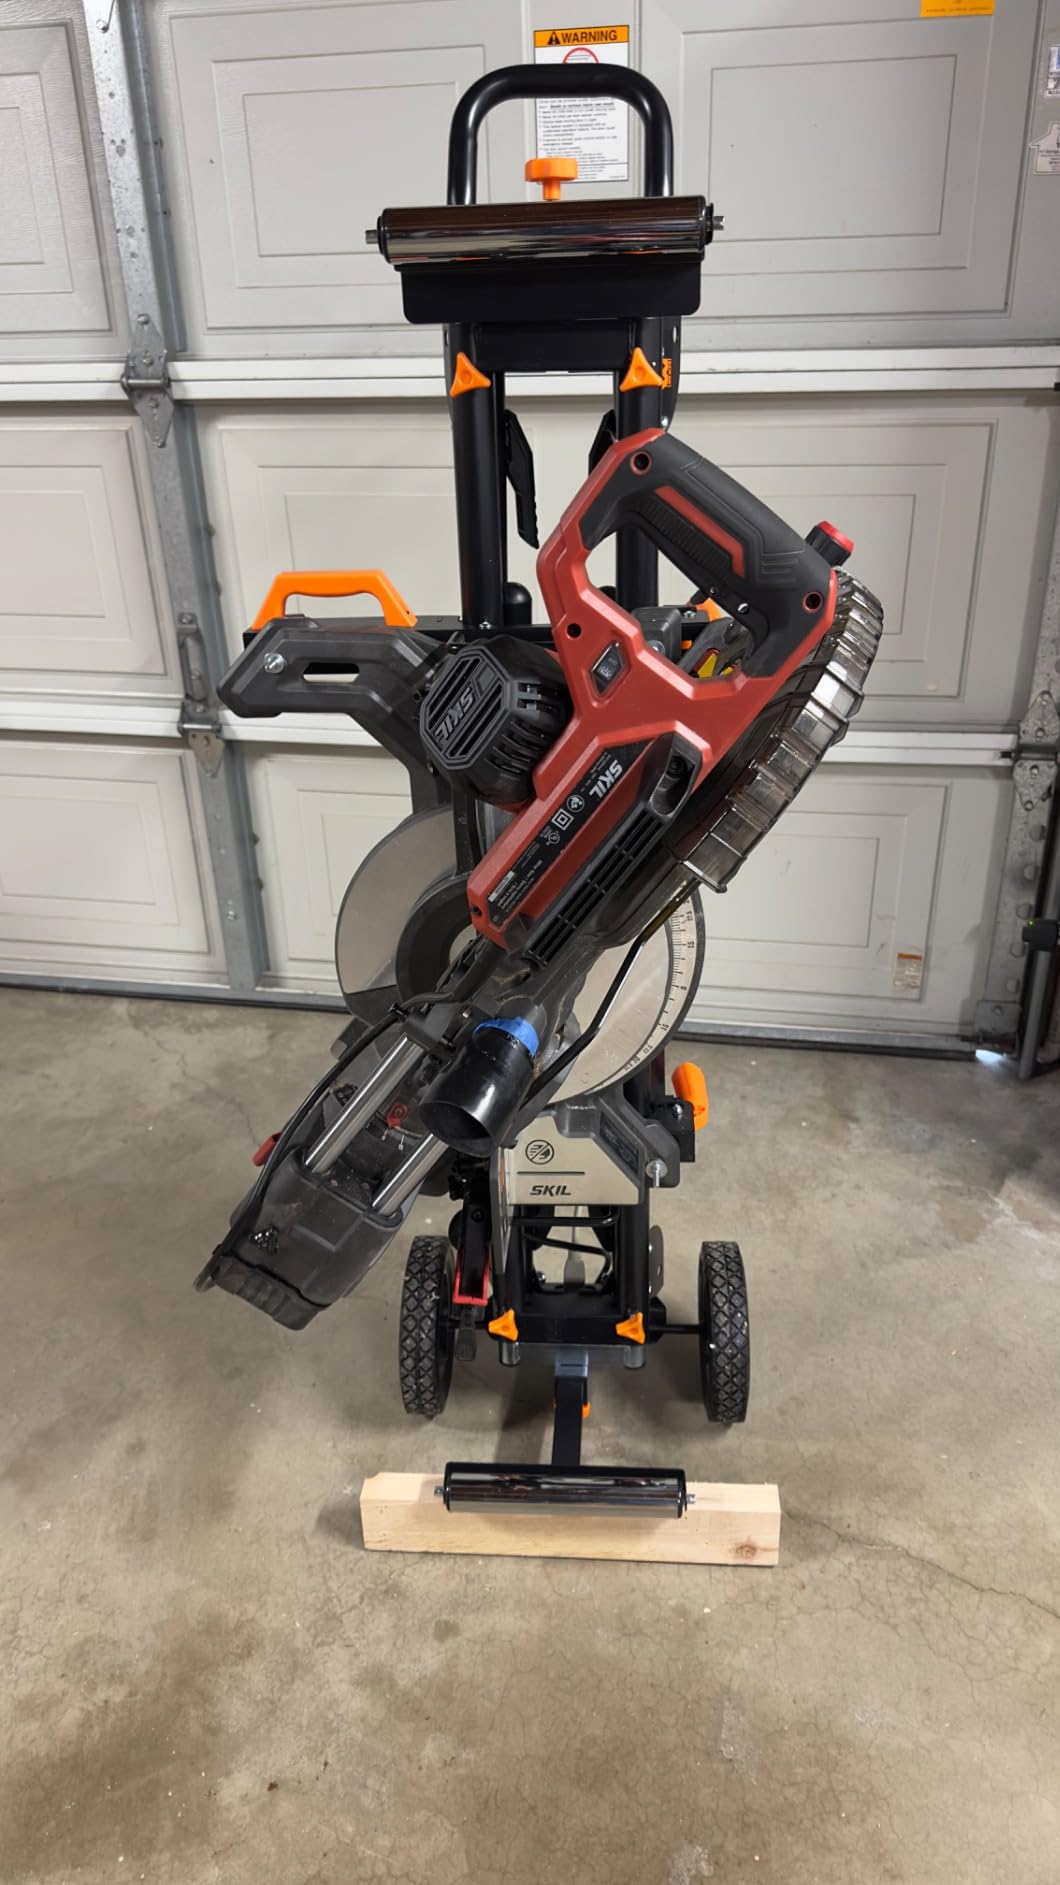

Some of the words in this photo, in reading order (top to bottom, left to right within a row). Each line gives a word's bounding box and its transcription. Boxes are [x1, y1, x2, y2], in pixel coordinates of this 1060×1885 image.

[561, 29, 618, 44] WARNING
[434, 687, 475, 745] SKIL
[589, 760, 623, 798] SKIL
[687, 941, 695, 949] 15
[660, 1023, 669, 1031] 15
[530, 1184, 571, 1197] SKIL
